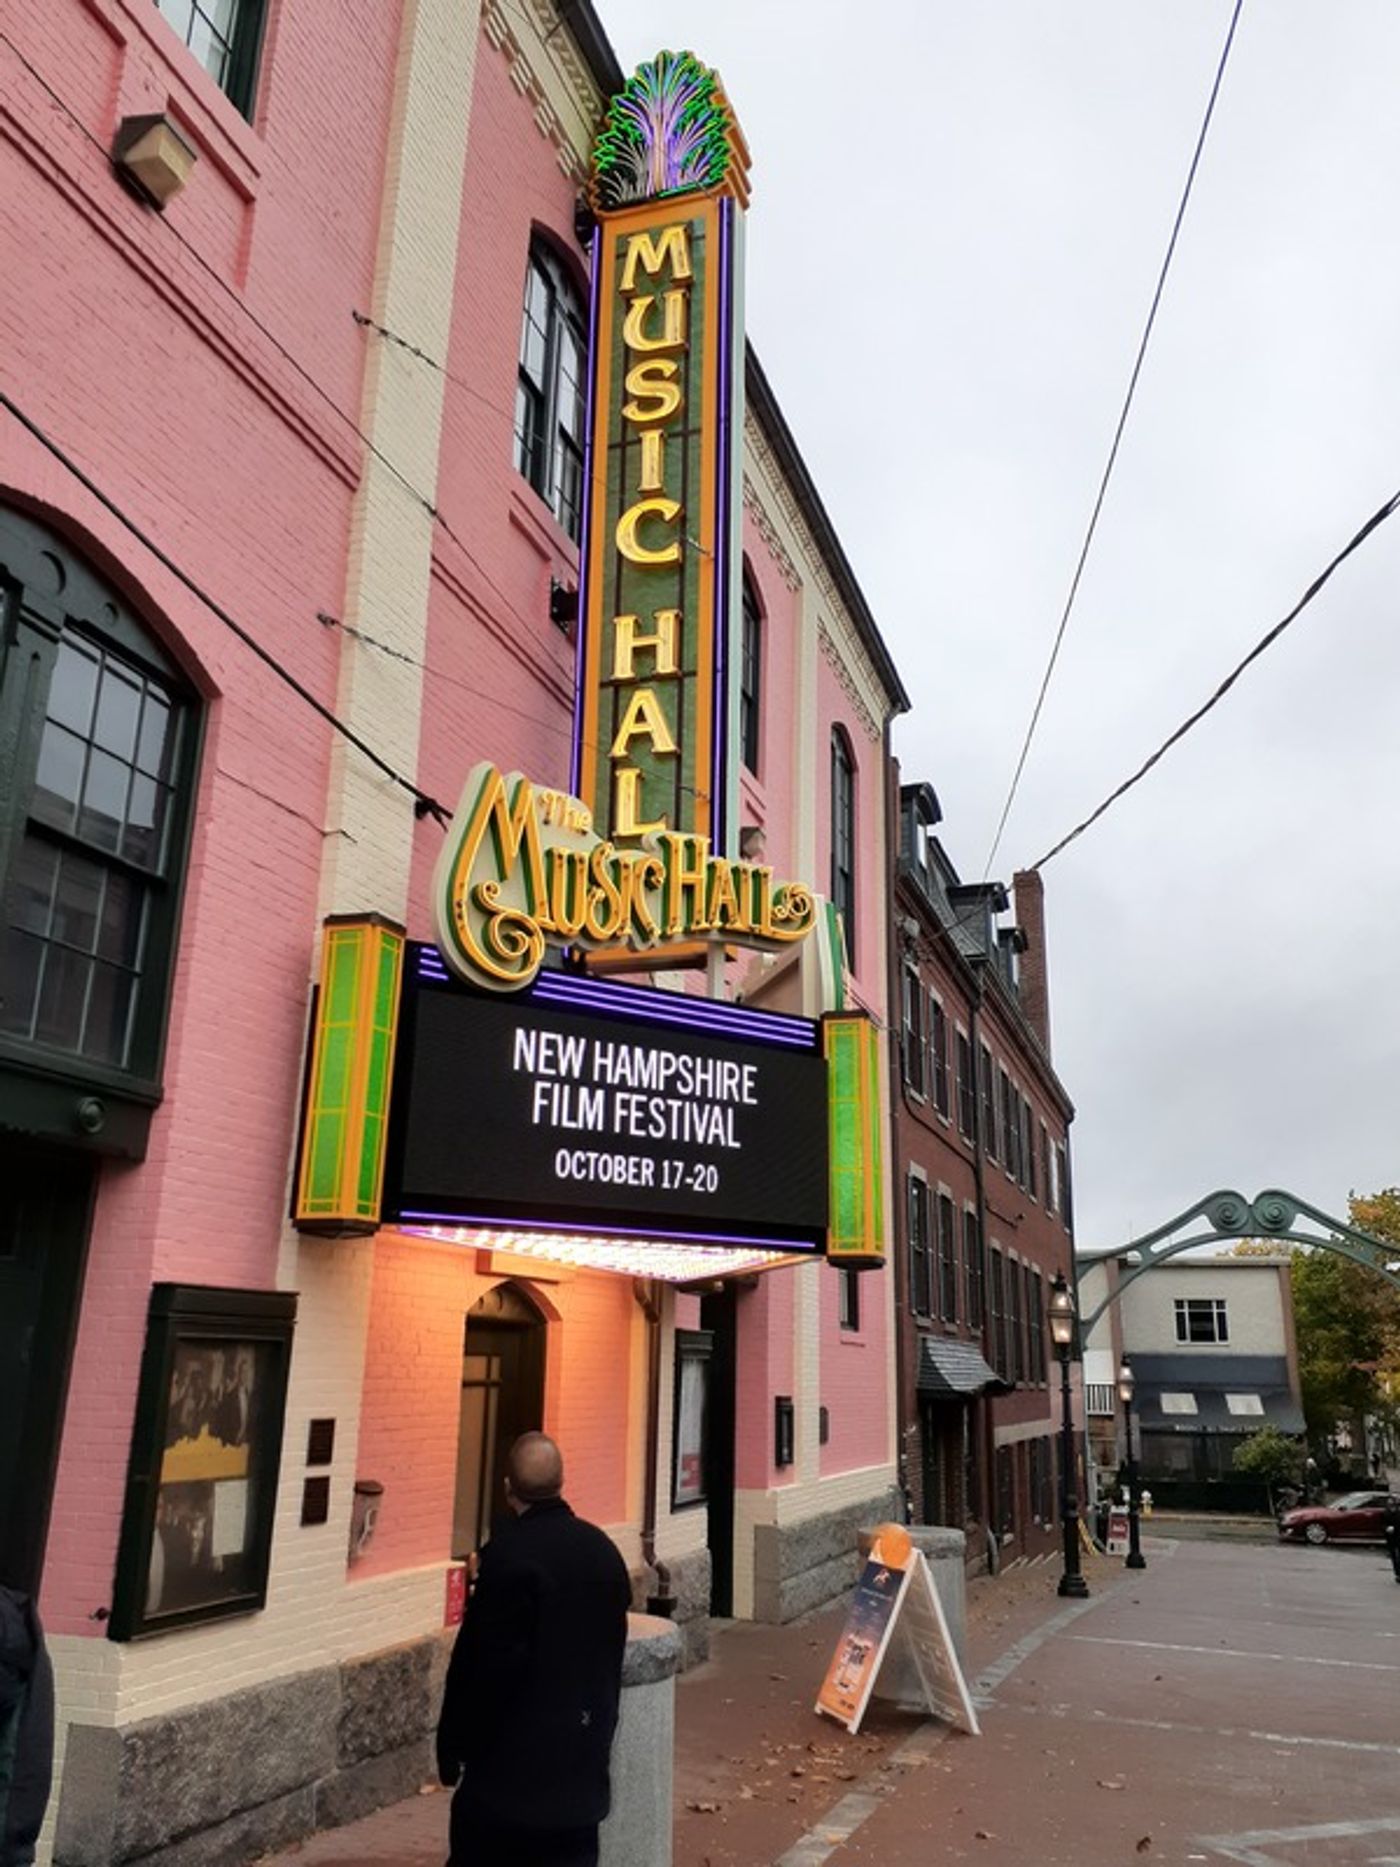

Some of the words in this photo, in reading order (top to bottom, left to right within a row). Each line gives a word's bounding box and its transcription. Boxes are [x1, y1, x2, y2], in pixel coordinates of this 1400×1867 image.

[616, 223, 692, 564] MUSIC
[608, 608, 683, 837] HAL
[540, 792, 592, 833] The
[513, 1027, 587, 1080] NEW
[593, 1040, 758, 1105] HAMPSHIRE
[532, 1081, 605, 1131] FILM
[614, 1092, 741, 1148] FESTIVAL
[555, 1149, 654, 1187] OCTOBER
[661, 1160, 718, 1193] 17-20
